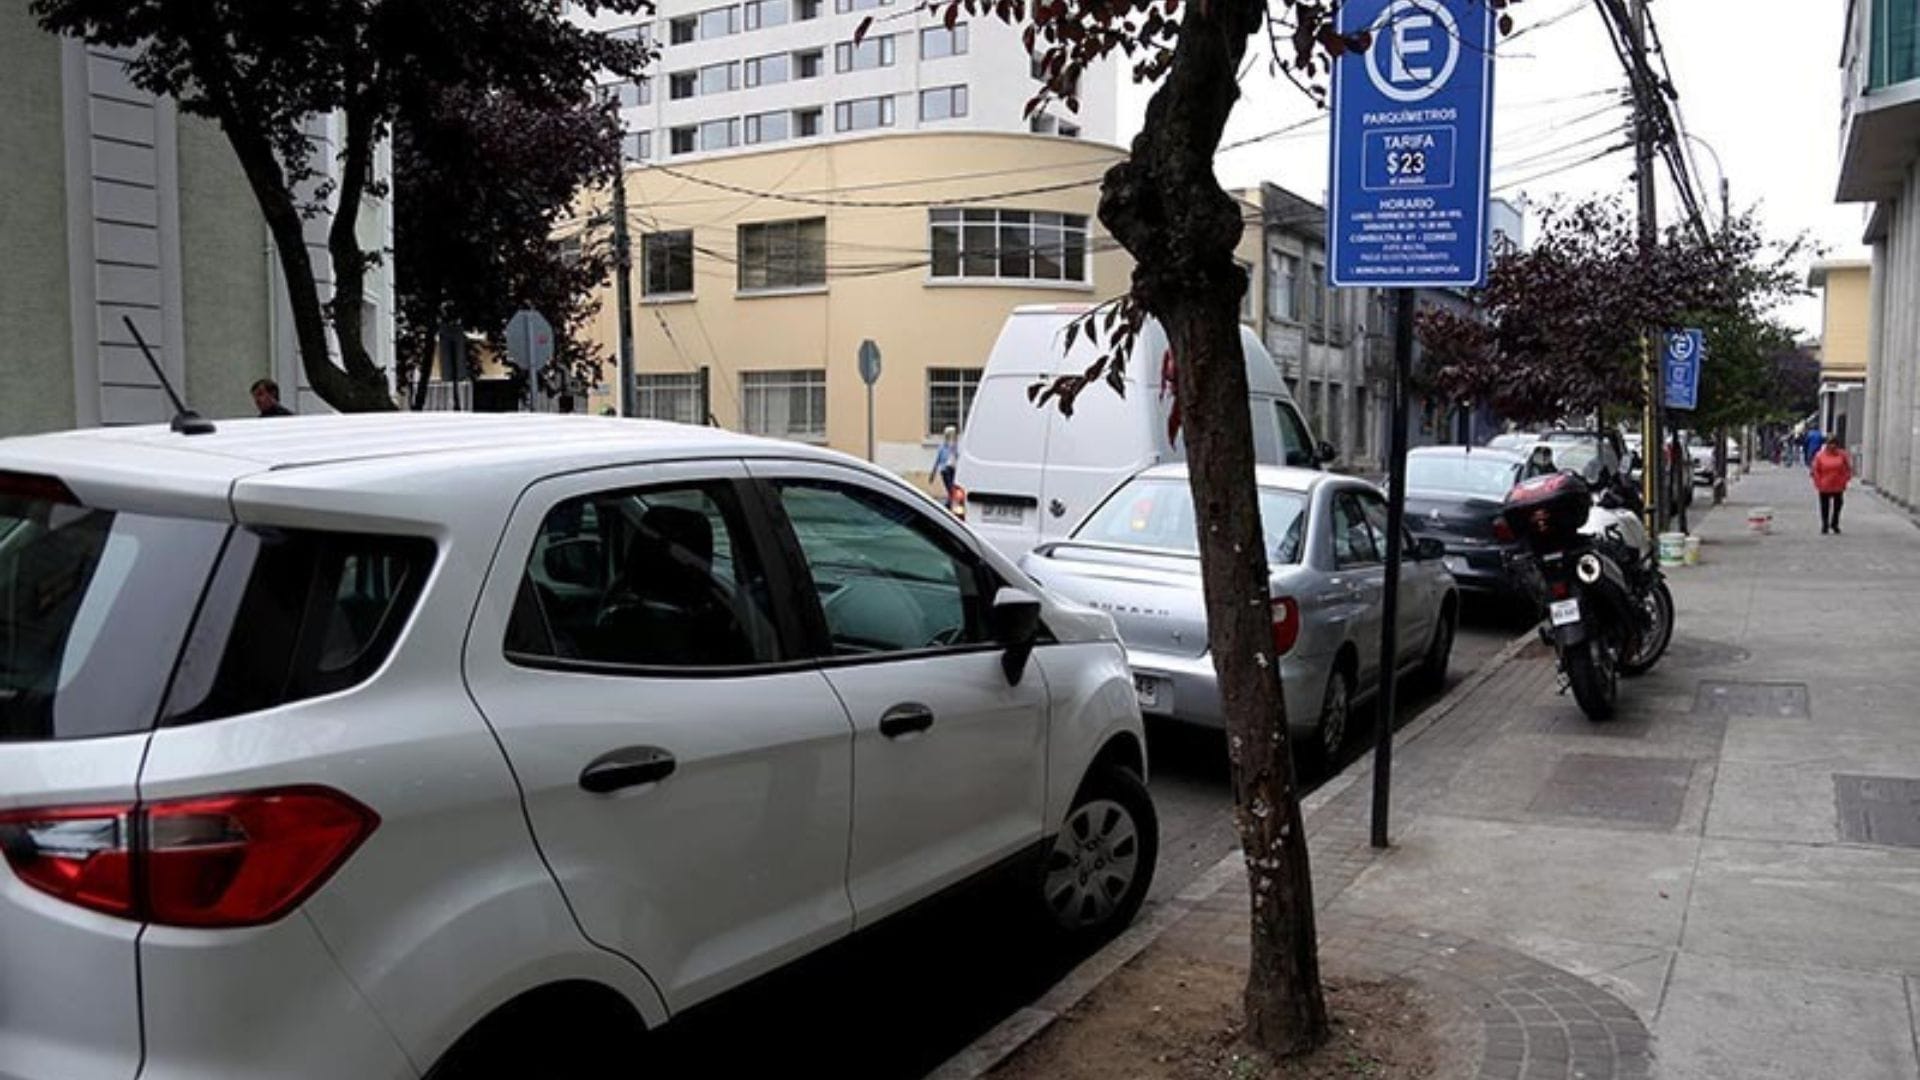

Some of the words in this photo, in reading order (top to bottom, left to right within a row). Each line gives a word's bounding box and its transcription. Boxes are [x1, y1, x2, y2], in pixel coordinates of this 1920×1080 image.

[1391, 15, 1433, 82] E
[1383, 134, 1435, 150] TARIFA
[1379, 198, 1435, 210] HORARIO
